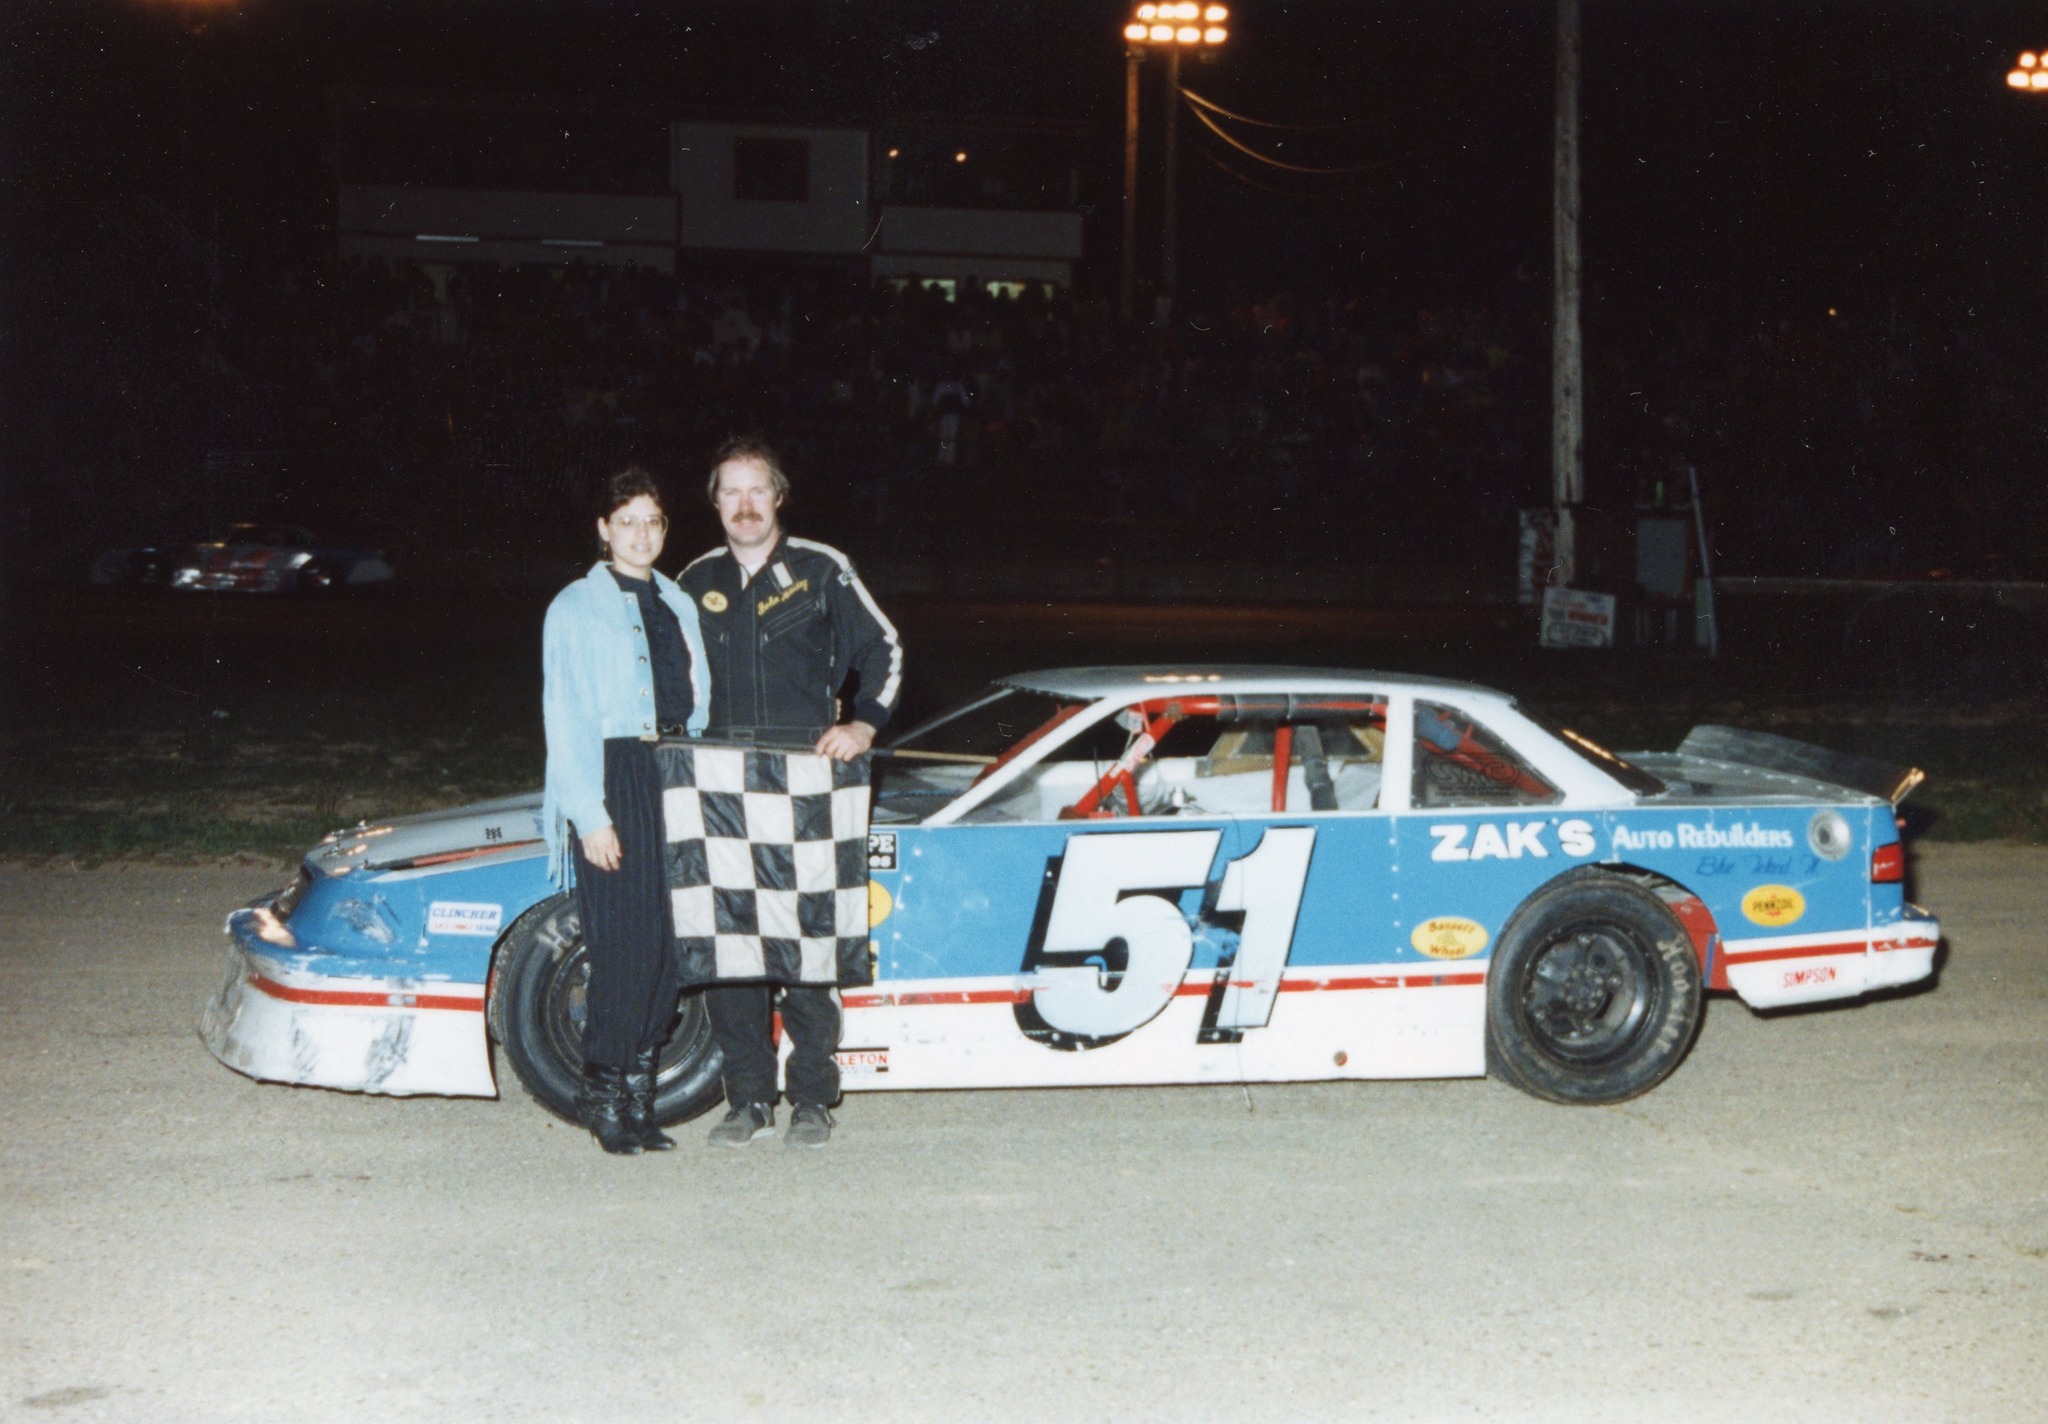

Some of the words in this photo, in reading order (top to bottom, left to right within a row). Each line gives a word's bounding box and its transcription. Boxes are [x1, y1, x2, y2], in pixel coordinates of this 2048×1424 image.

[431, 907, 498, 920] CLINCHER
[1752, 898, 1794, 912] PENNZOIL
[1014, 826, 1318, 1050] 51
[1782, 966, 1838, 989] SIMPSON
